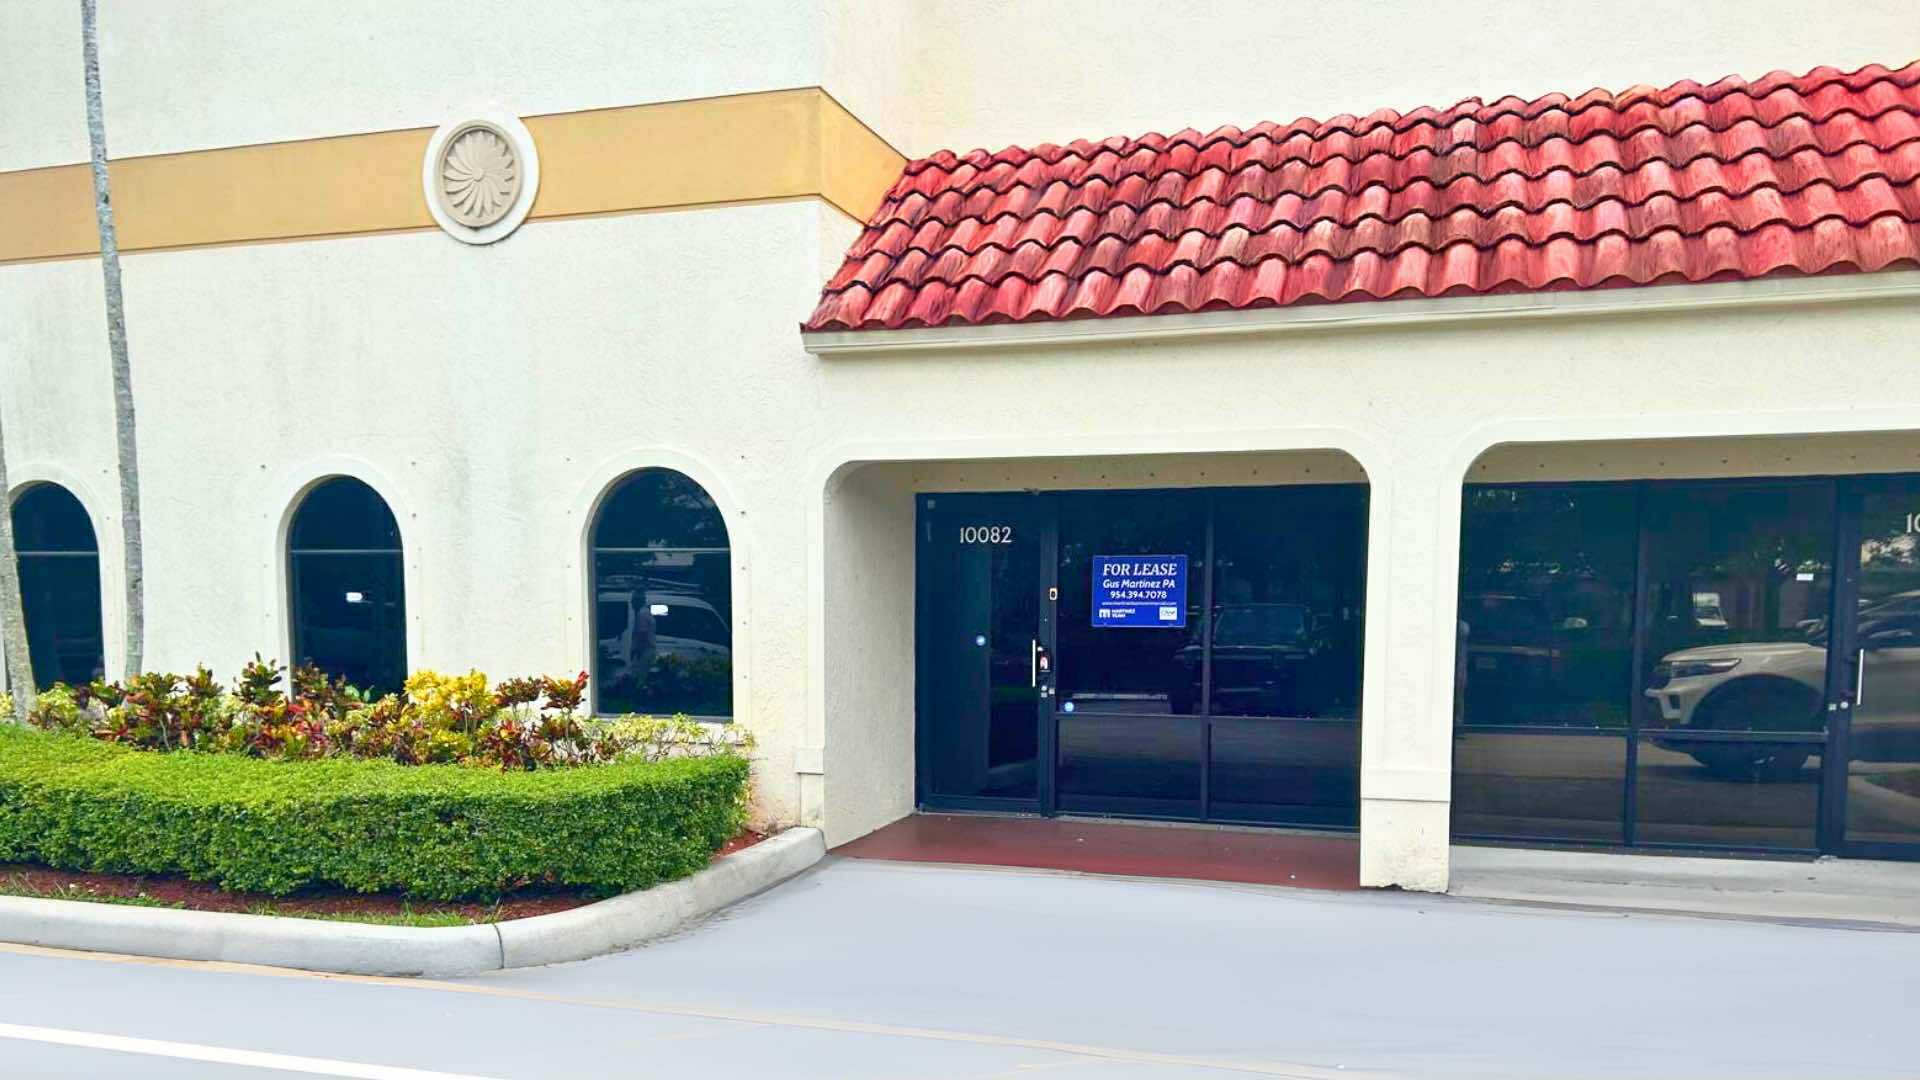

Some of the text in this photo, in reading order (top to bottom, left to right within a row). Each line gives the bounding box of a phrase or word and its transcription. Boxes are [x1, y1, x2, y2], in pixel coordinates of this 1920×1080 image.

[960, 526, 1012, 544] 10082
[1103, 563, 1178, 576] FOR LEASE
[1103, 579, 1176, 589] Gus Martinez PA
[1110, 590, 1167, 599] 954.394.7078
